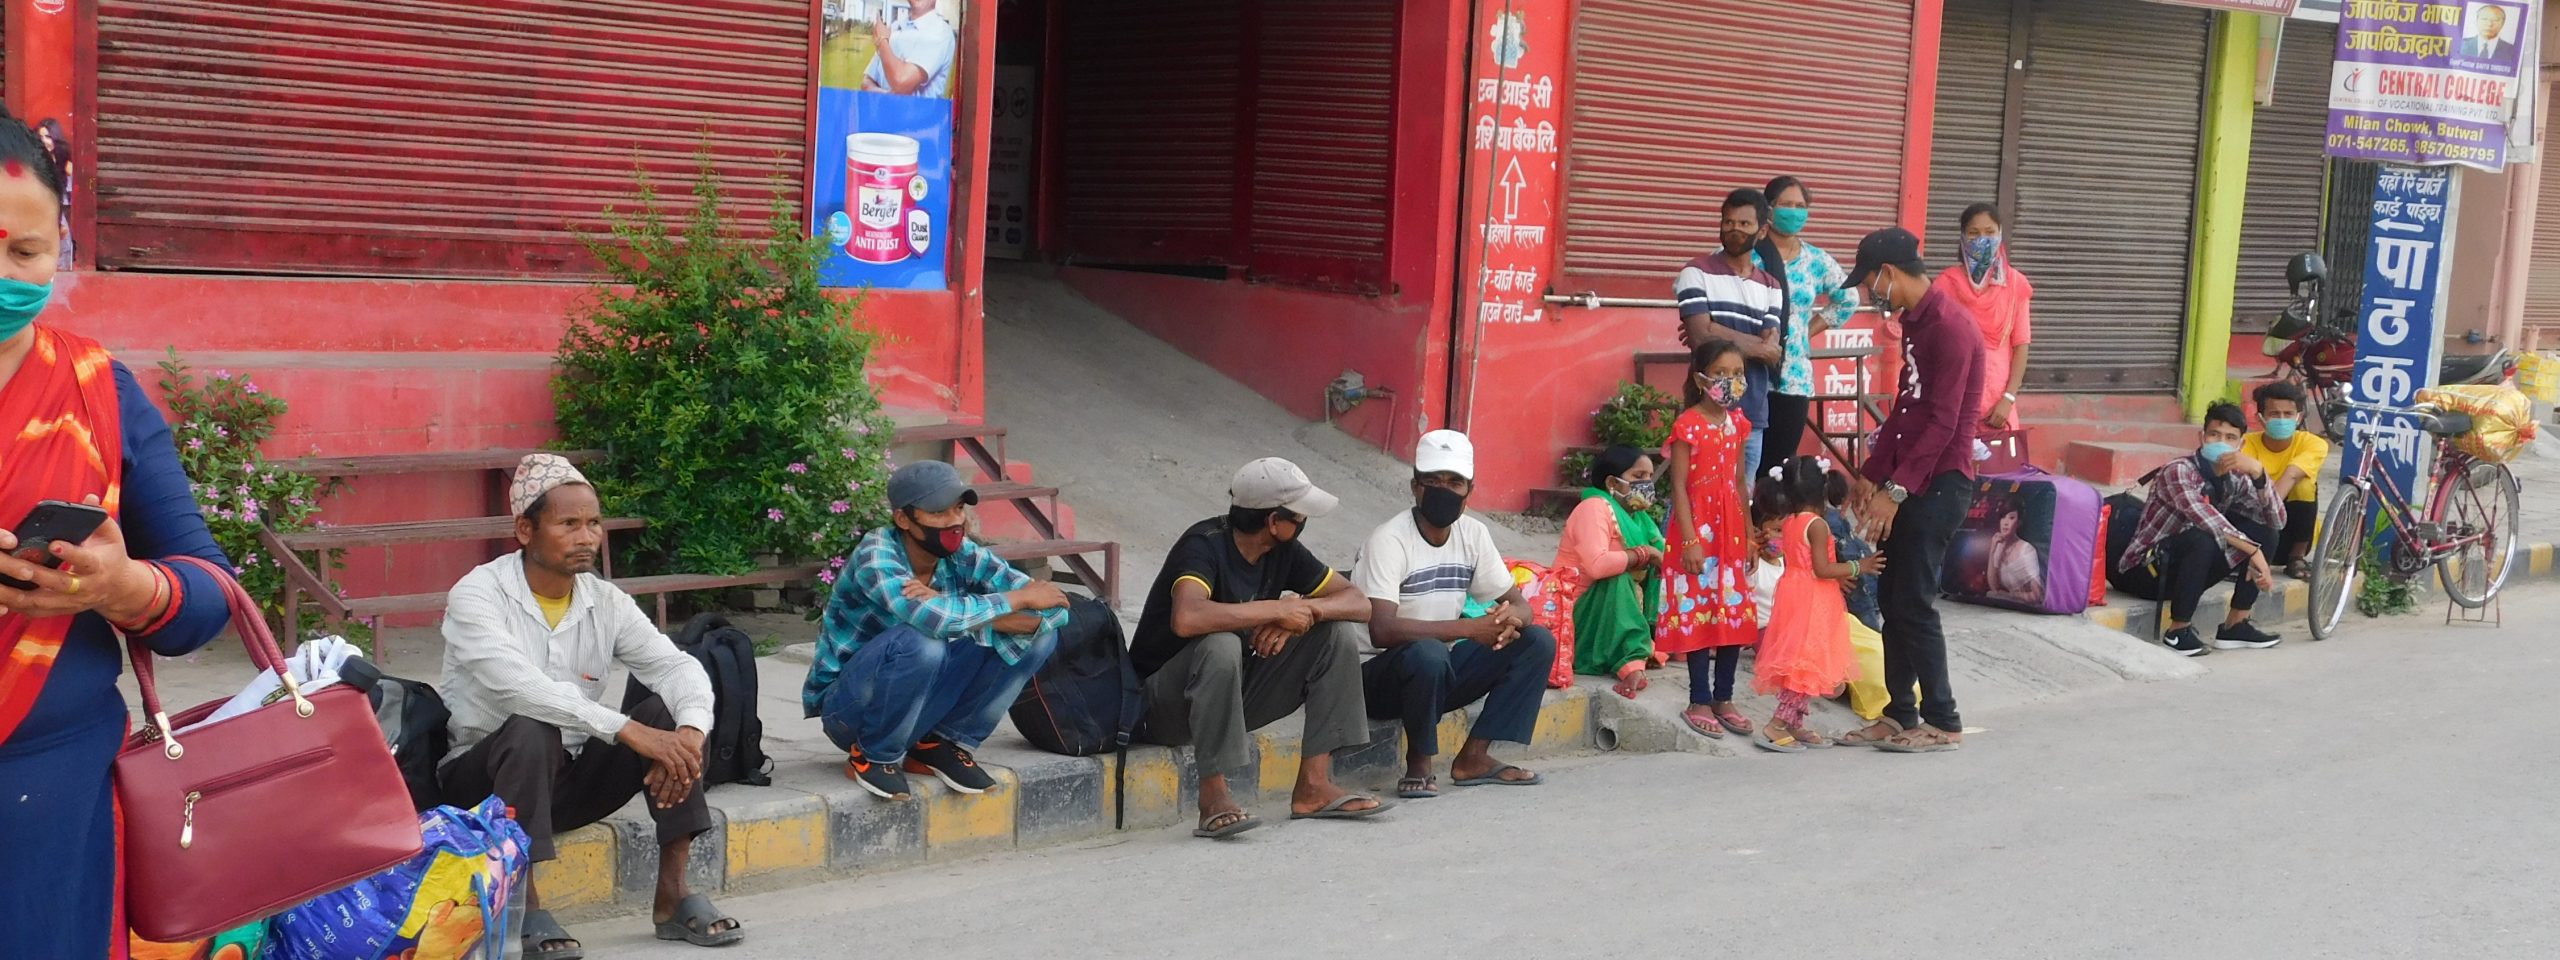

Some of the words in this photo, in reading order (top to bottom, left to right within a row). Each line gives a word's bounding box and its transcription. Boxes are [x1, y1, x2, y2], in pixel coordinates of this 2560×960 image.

[2421, 3, 2463, 26] भाषा
[2378, 69, 2440, 98] CENTRAL
[2443, 74, 2506, 107] COLLEGE
[2377, 99, 2388, 108] OF
[2389, 100, 2434, 113] VOCATIONAL
[2343, 115, 2381, 131] Milan
[2385, 117, 2433, 138] Chowk,
[2437, 122, 2484, 142] Butwal
[2328, 133, 2410, 156] 071-547265,
[2414, 139, 2496, 162] 9857058795
[861, 202, 898, 222] Berger
[911, 221, 928, 233] Dust
[855, 235, 875, 250] ANTI
[876, 237, 899, 251] DUST
